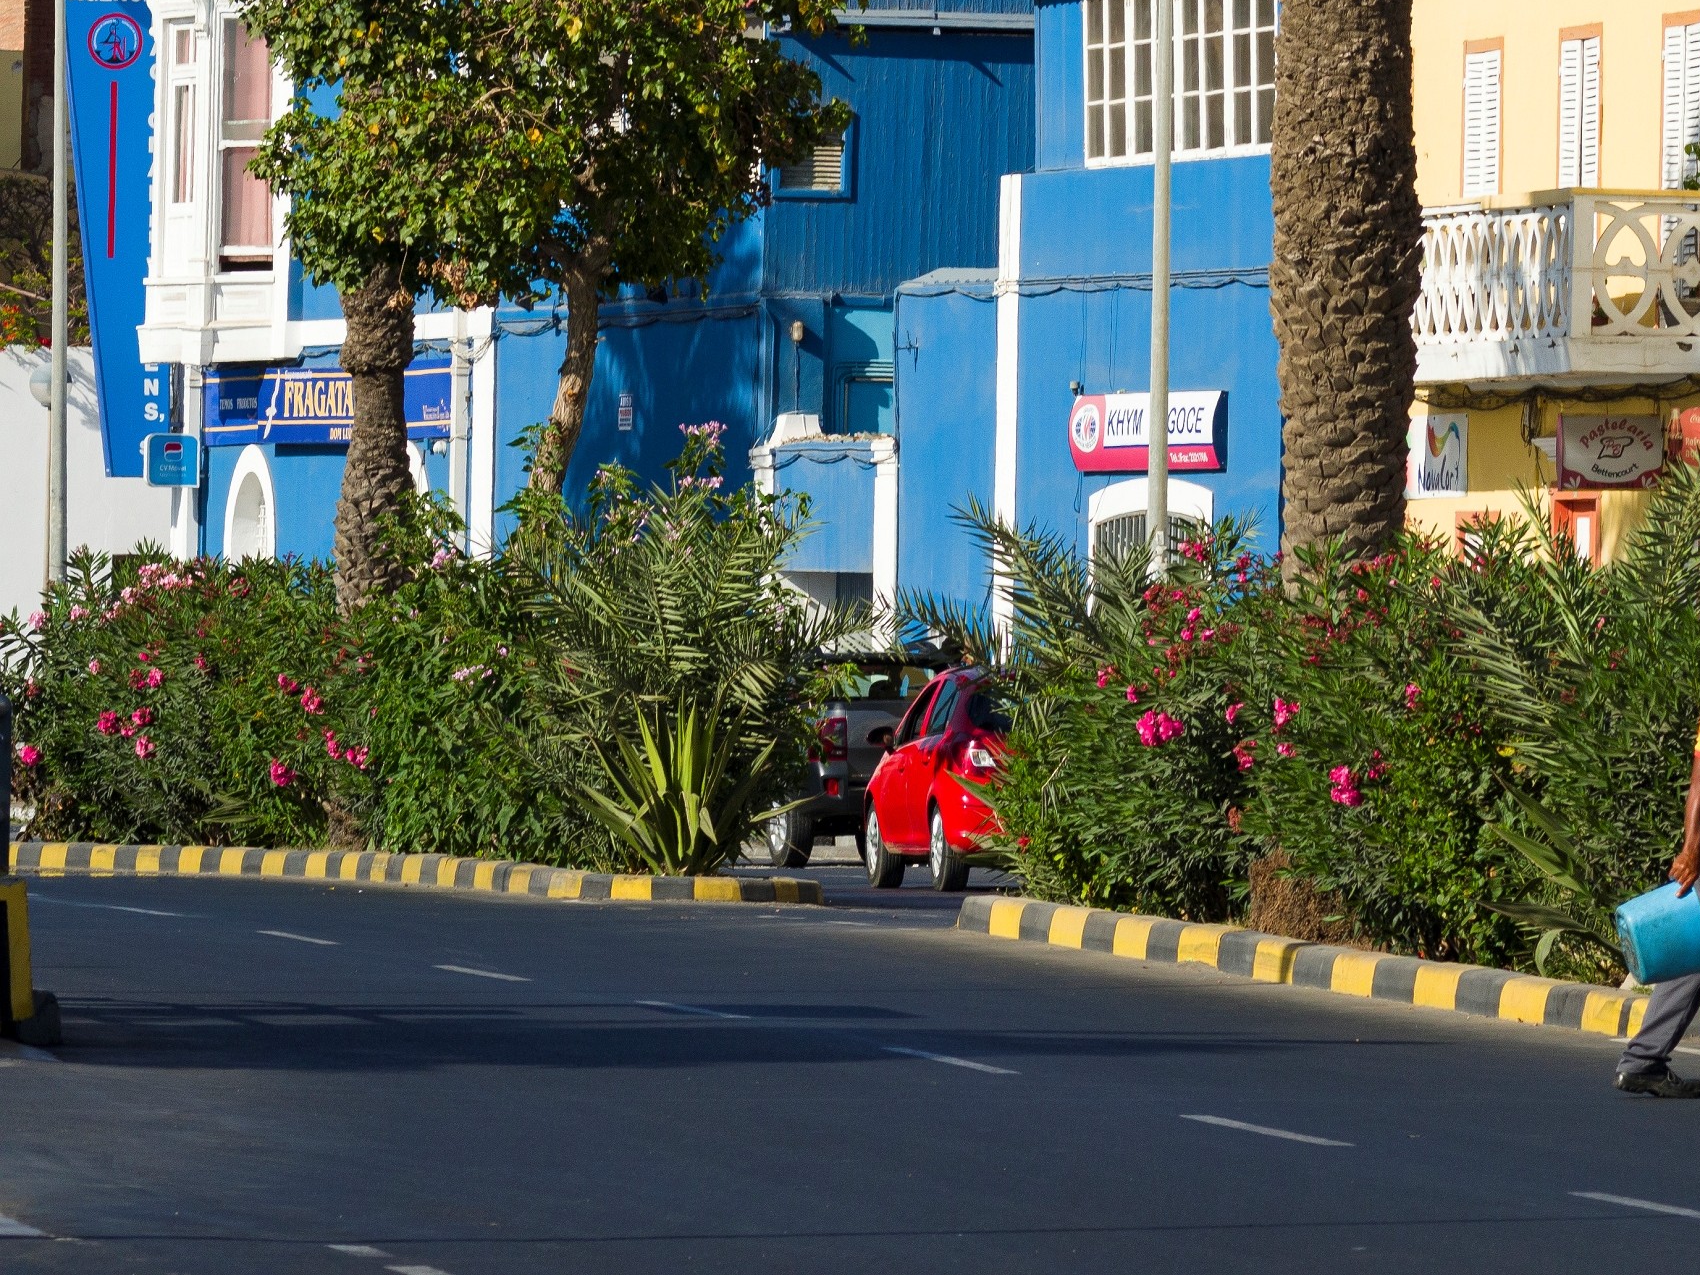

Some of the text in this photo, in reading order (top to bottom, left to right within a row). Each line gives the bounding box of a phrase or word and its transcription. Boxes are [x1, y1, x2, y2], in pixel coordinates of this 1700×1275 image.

[284, 381, 355, 417] FRAGATA
[1107, 408, 1144, 436] KHYM
[1168, 406, 1204, 434] GOCE
[1580, 418, 1653, 450] Pastelaria
[1591, 463, 1640, 479] Bettencourt
